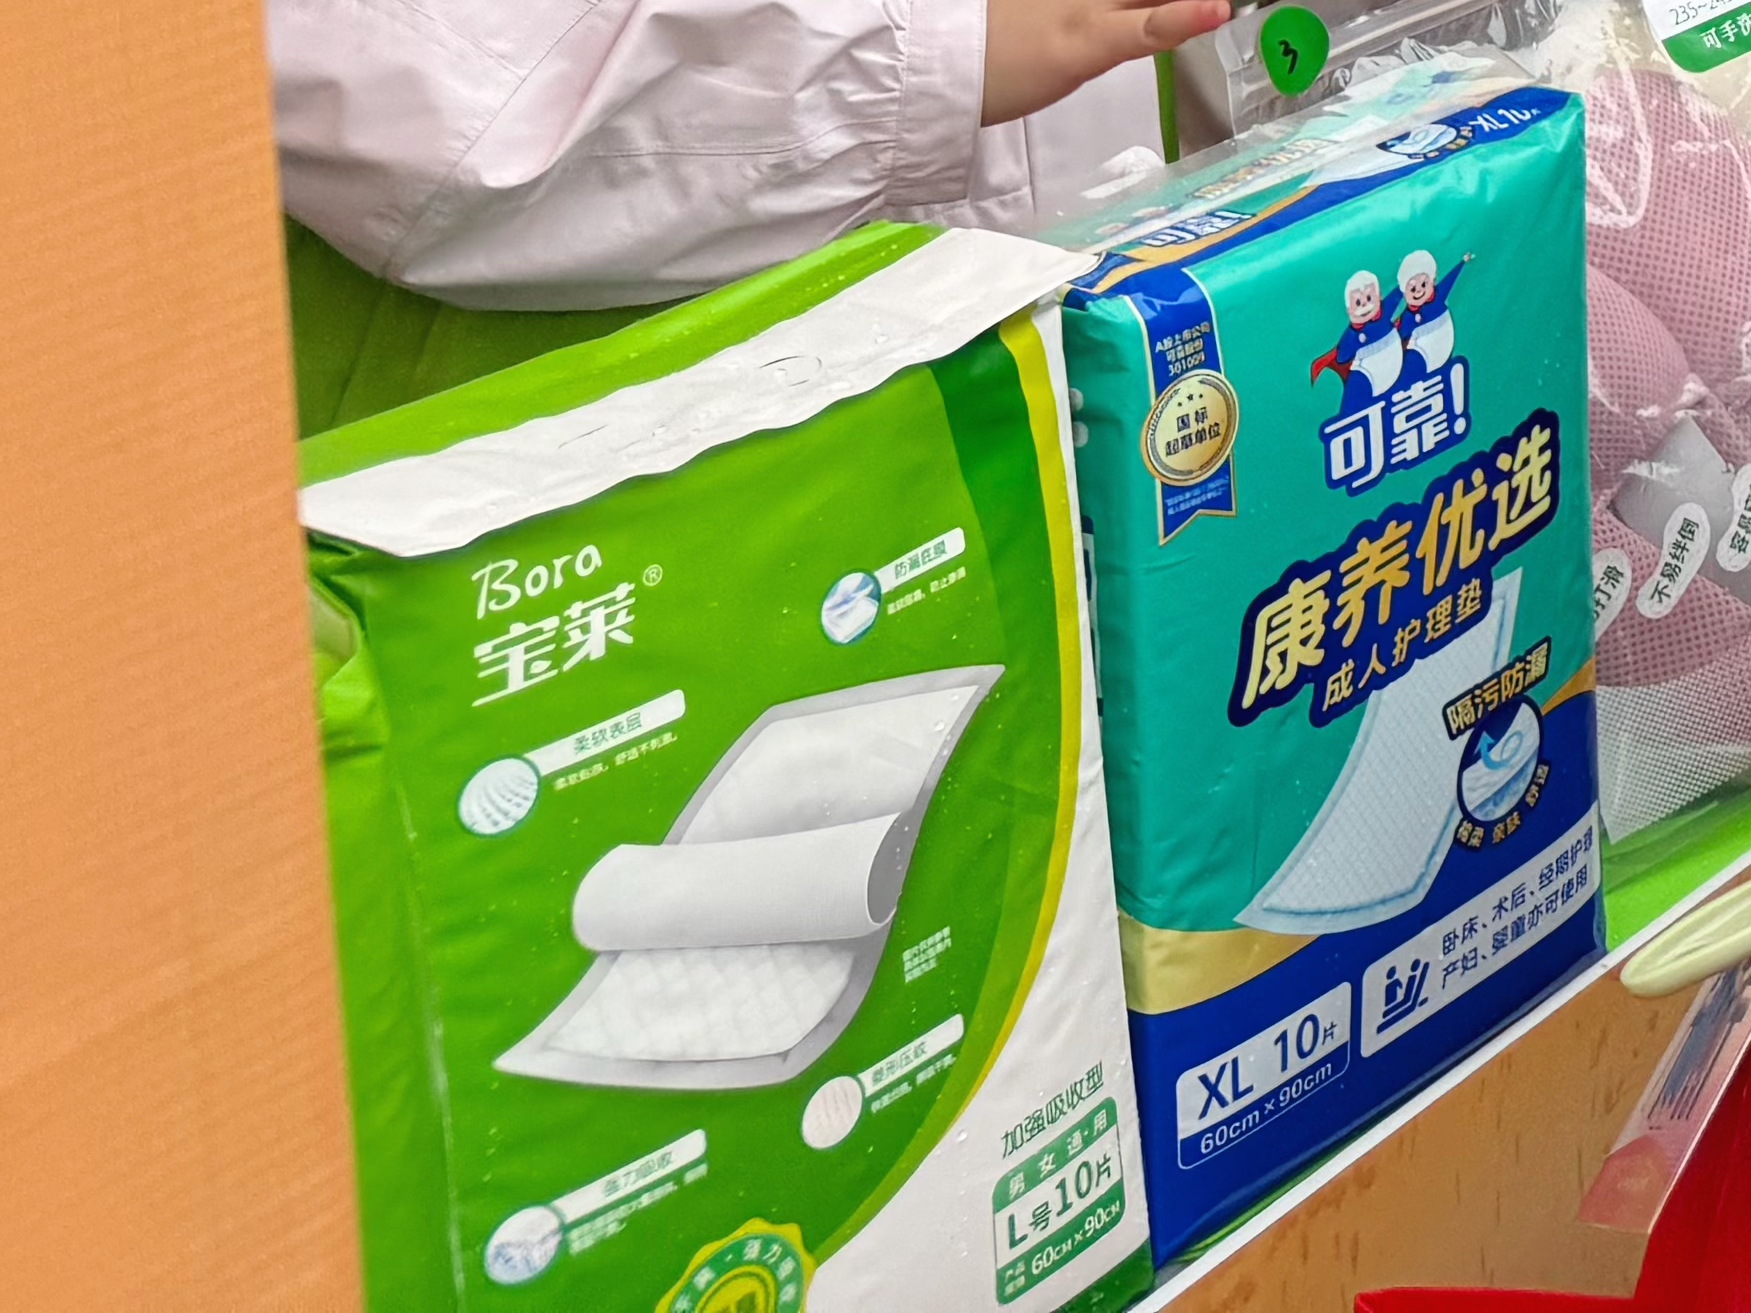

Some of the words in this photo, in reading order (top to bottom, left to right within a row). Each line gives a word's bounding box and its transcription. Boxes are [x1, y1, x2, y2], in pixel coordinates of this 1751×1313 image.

[471, 545, 602, 620] Bora
[1241, 426, 1551, 709] 康养优选
[1650, 517, 1699, 604] 不易绊倒
[1321, 579, 1482, 711] 成人护理垫
[1446, 647, 1548, 732] 隔污防漏
[1198, 1056, 1254, 1120] XL
